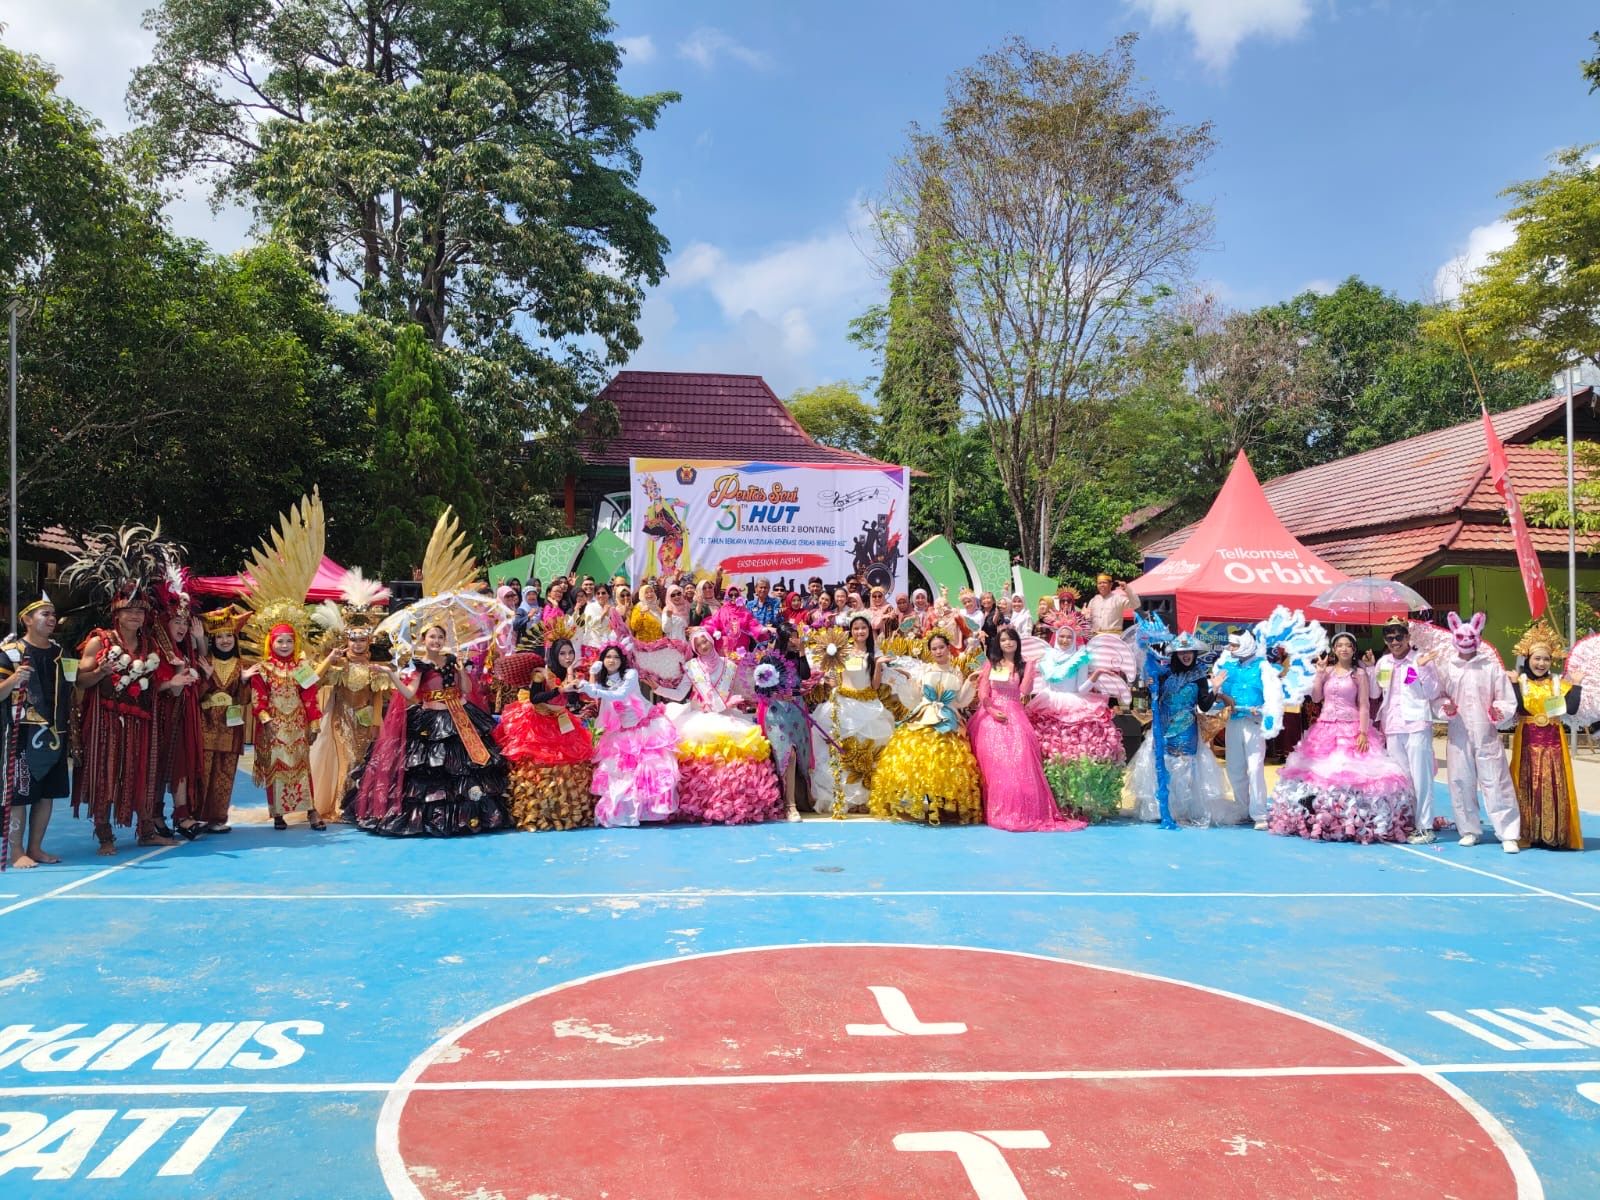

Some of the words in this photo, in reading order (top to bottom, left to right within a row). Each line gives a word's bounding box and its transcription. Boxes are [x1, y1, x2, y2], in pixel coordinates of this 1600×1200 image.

[707, 473, 767, 508] Pentas
[768, 482, 799, 504] Seni
[749, 505, 800, 524] HUT
[741, 524, 760, 533] SMA
[761, 525, 789, 533] NEGERI
[791, 525, 796, 533] 2
[797, 525, 835, 534] BONTANG
[1216, 548, 1299, 560] Telkomsel
[1224, 561, 1333, 585] Orbit
